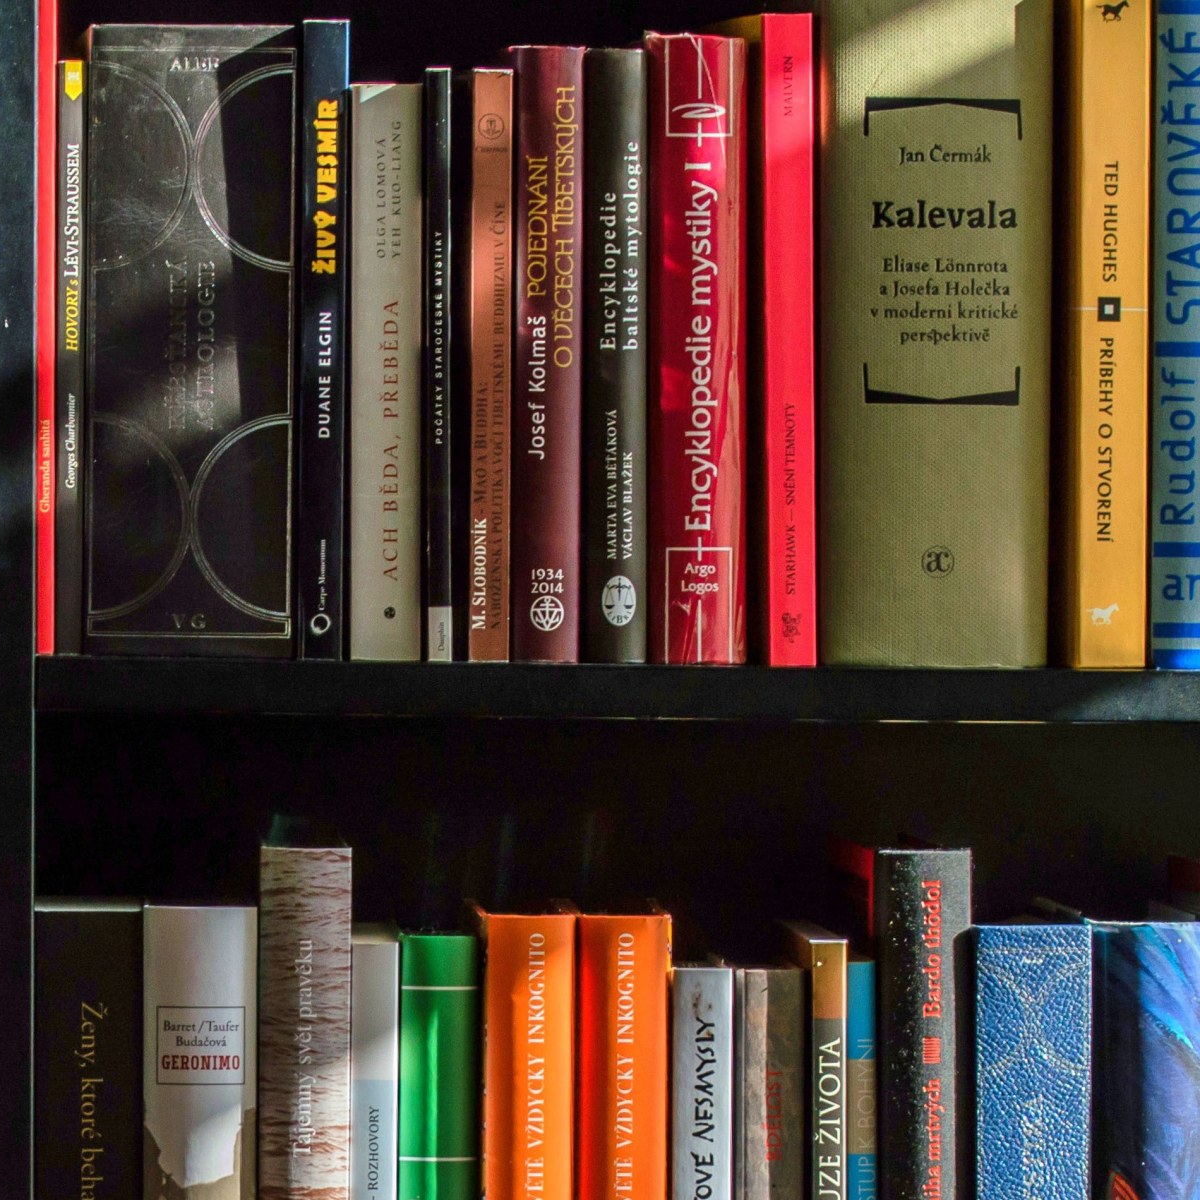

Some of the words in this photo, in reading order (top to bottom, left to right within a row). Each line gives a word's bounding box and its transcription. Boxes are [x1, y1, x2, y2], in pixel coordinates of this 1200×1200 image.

[312, 100, 338, 201] VESMÍR
[552, 86, 577, 229] TIBETSKÝCH
[898, 146, 925, 164] Jan
[929, 144, 991, 165] Čermák
[1104, 161, 1118, 196] TED
[525, 155, 549, 297] POJEDNÁNÍ
[623, 142, 642, 257] mytologie
[872, 201, 1017, 230] Kalevala
[313, 211, 336, 274] ŽIVÝ
[599, 191, 620, 350] Encyklopedie
[684, 181, 718, 305] mystiky
[1103, 205, 1118, 282] HUGHES
[318, 311, 331, 366] ELGIN
[622, 267, 640, 350] baltské
[528, 315, 546, 393] Kolmaš
[555, 346, 573, 367] O
[317, 375, 331, 438] DUANE
[527, 403, 547, 460] Josef
[684, 314, 718, 531] Encyklopedie
[528, 932, 546, 1044] INKOGNITO
[75, 1001, 107, 1068] Ženy,
[161, 1054, 241, 1072] GERONIMO
[80, 1078, 105, 1138] ktoré
[525, 1053, 545, 1149] VŽDYCKY
[815, 1037, 841, 1145] ŽIVOTA
[922, 1078, 945, 1161] mrtvých
